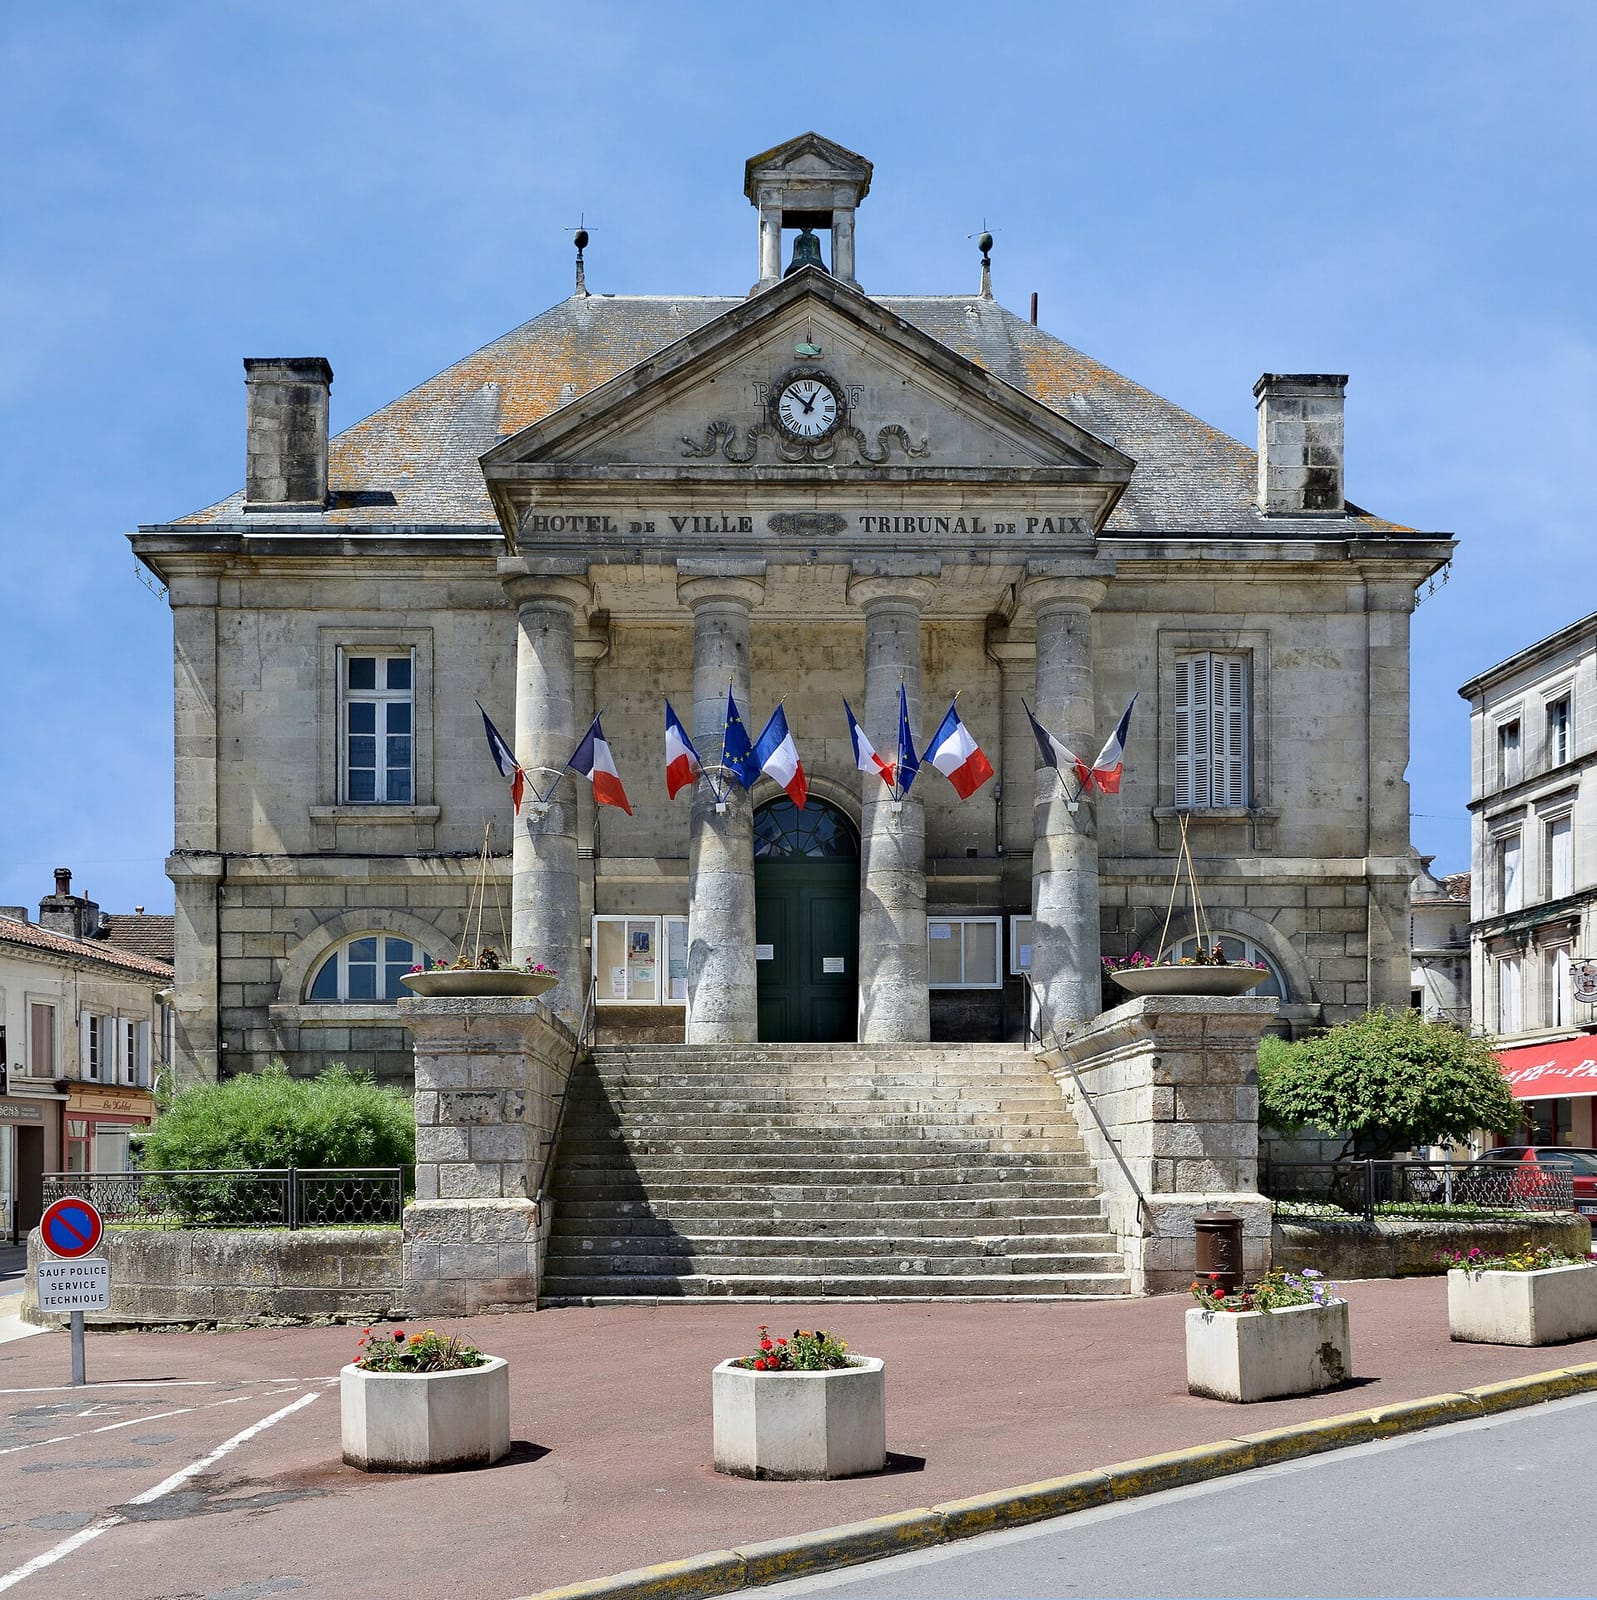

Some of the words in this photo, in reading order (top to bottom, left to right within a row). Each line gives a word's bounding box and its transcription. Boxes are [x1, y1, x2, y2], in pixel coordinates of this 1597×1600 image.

[753, 382, 769, 406] R
[845, 385, 864, 409] F
[533, 515, 617, 533] HOTEL
[629, 521, 655, 533] DE
[668, 516, 753, 533] VILLE
[859, 516, 986, 534] TRIBUNAL
[994, 523, 1016, 534] DE
[1025, 517, 1084, 534] PAIX
[39, 1268, 66, 1277] SAUF
[70, 1266, 107, 1276] POLICE
[51, 1281, 96, 1291] SERVICE
[44, 1294, 105, 1305] TECHNIQUE
